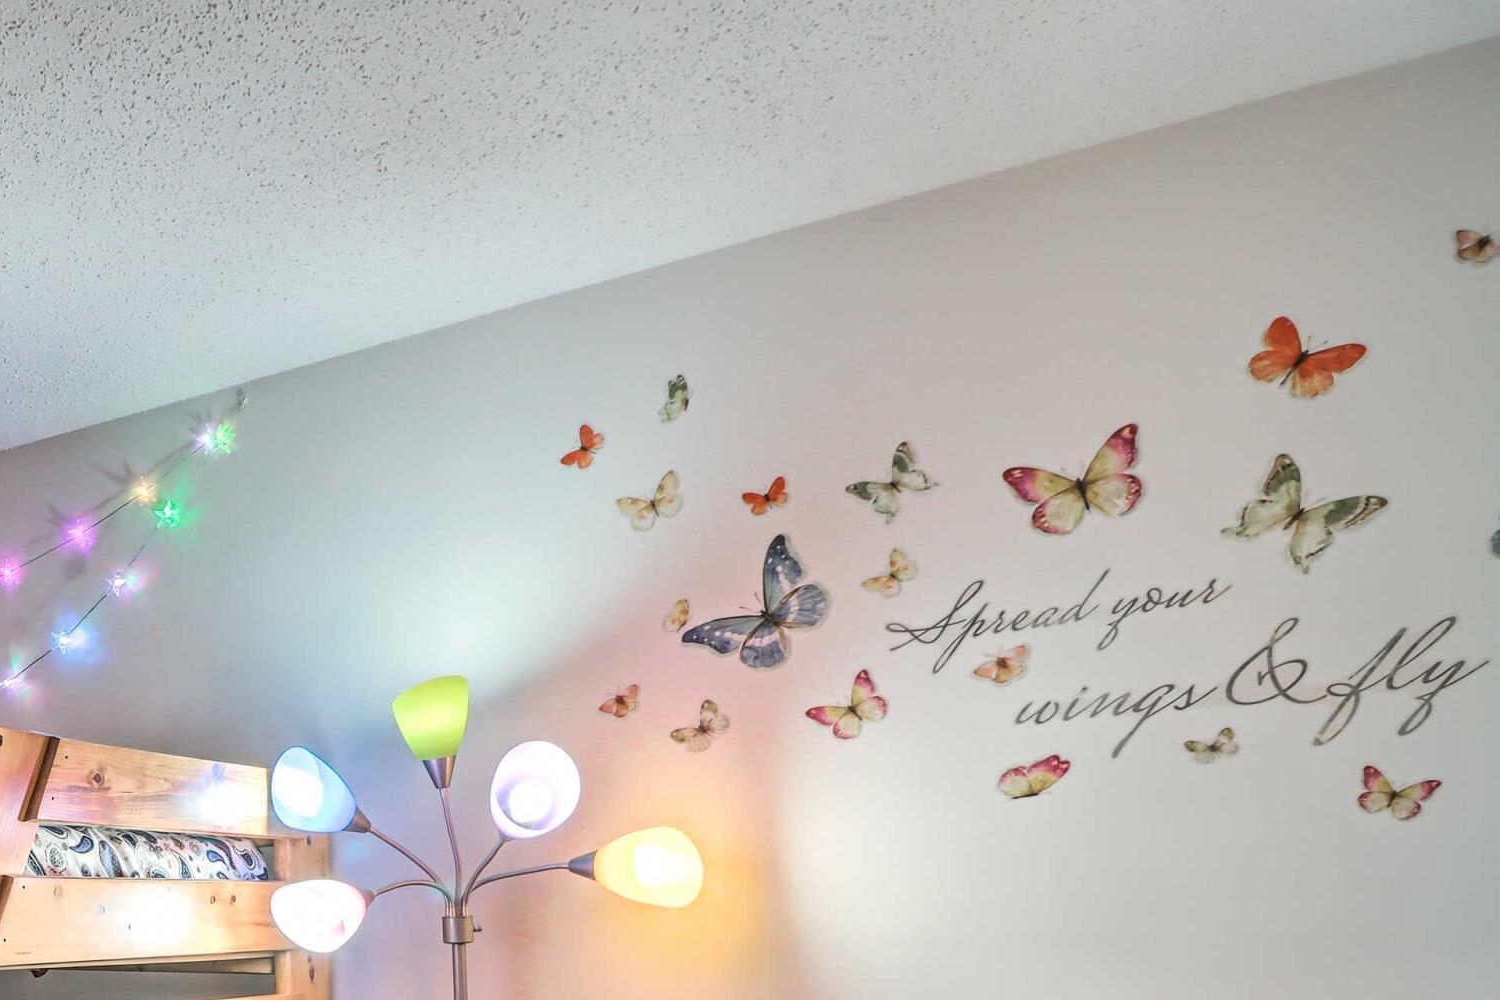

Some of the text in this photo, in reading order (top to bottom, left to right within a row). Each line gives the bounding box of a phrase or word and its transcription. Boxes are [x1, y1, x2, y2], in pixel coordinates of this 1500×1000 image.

[886, 568, 1233, 674] Spread your
[1014, 615, 1490, 759] wings & fly
